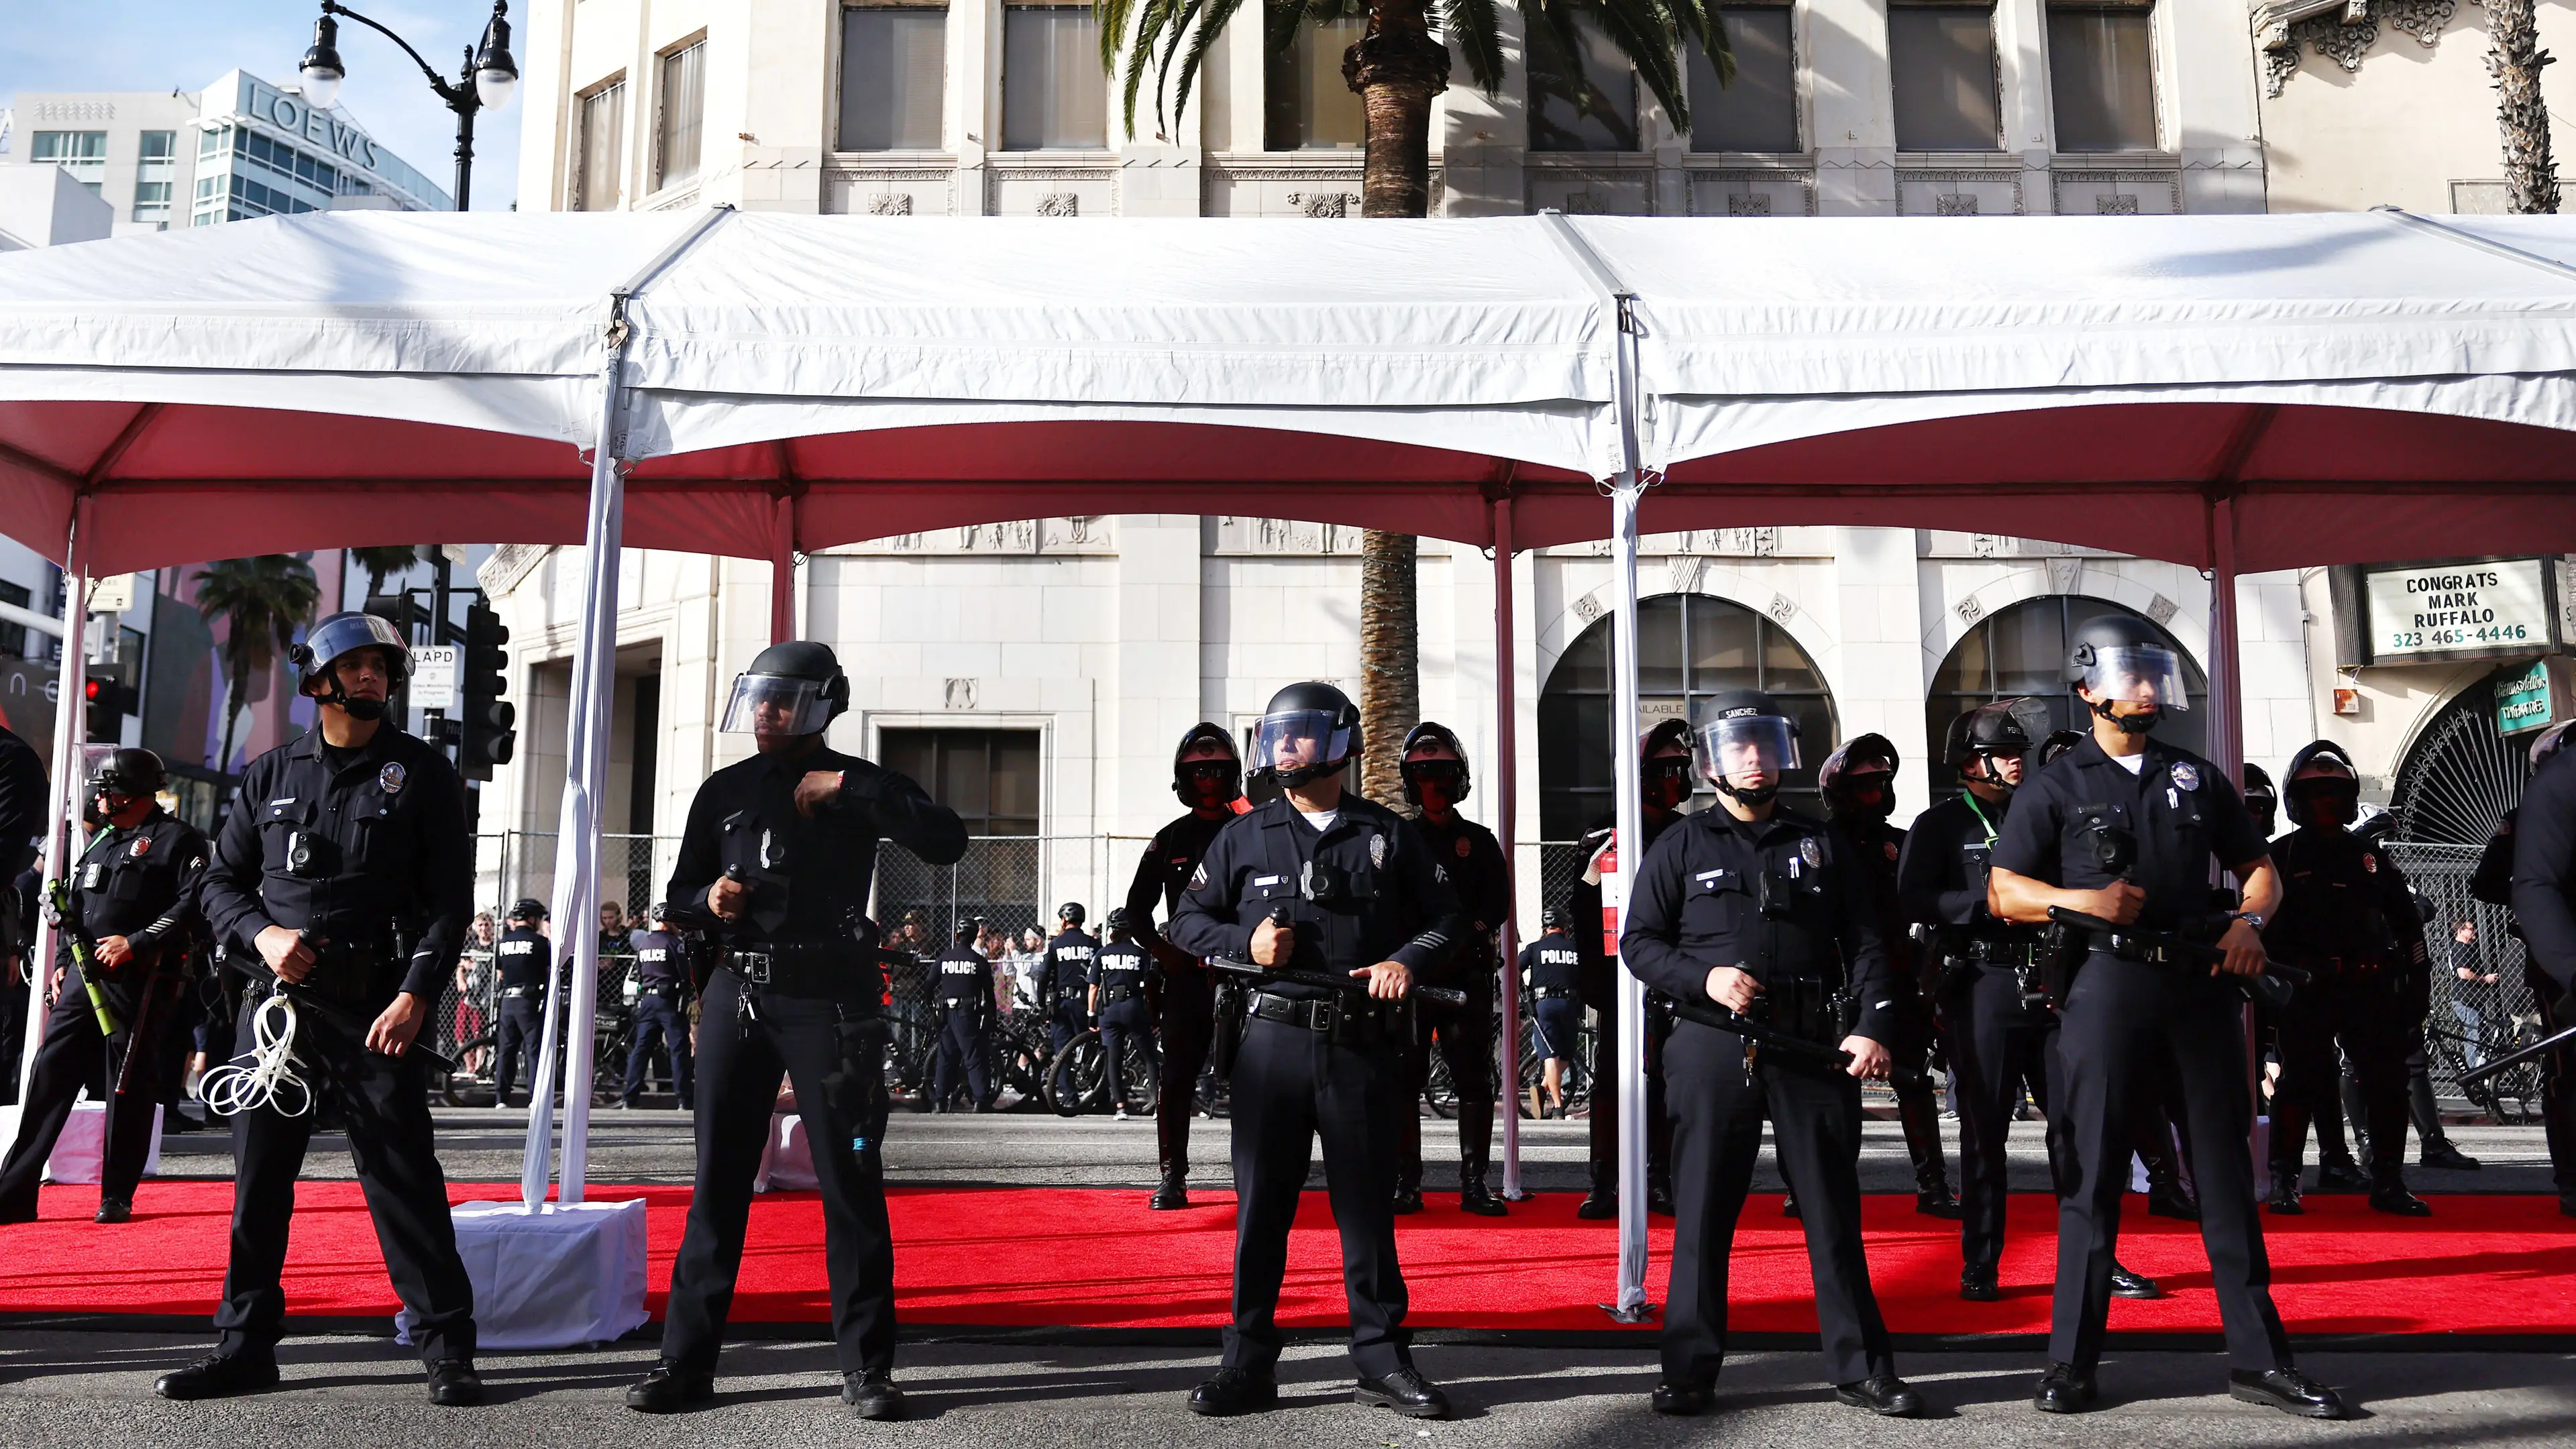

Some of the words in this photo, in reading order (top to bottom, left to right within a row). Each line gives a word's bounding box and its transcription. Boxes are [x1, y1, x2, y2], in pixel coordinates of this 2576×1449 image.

[251, 83, 378, 171] LOEWS
[2406, 572, 2498, 593] CONGRATS
[2428, 592, 2479, 609] MARK
[2414, 608, 2494, 628] RUFFALO
[2394, 632, 2423, 647] 323
[2432, 625, 2526, 645] 465-4446
[414, 651, 452, 662] LAPD
[1726, 708, 1758, 718] SANCHEZ
[499, 941, 533, 957] POLICE
[639, 949, 666, 963] POLICE
[1057, 946, 1094, 961] POLICE
[1540, 949, 1578, 965] POLICE
[941, 961, 976, 974] POLICE
[1101, 954, 1140, 971] POLICE
